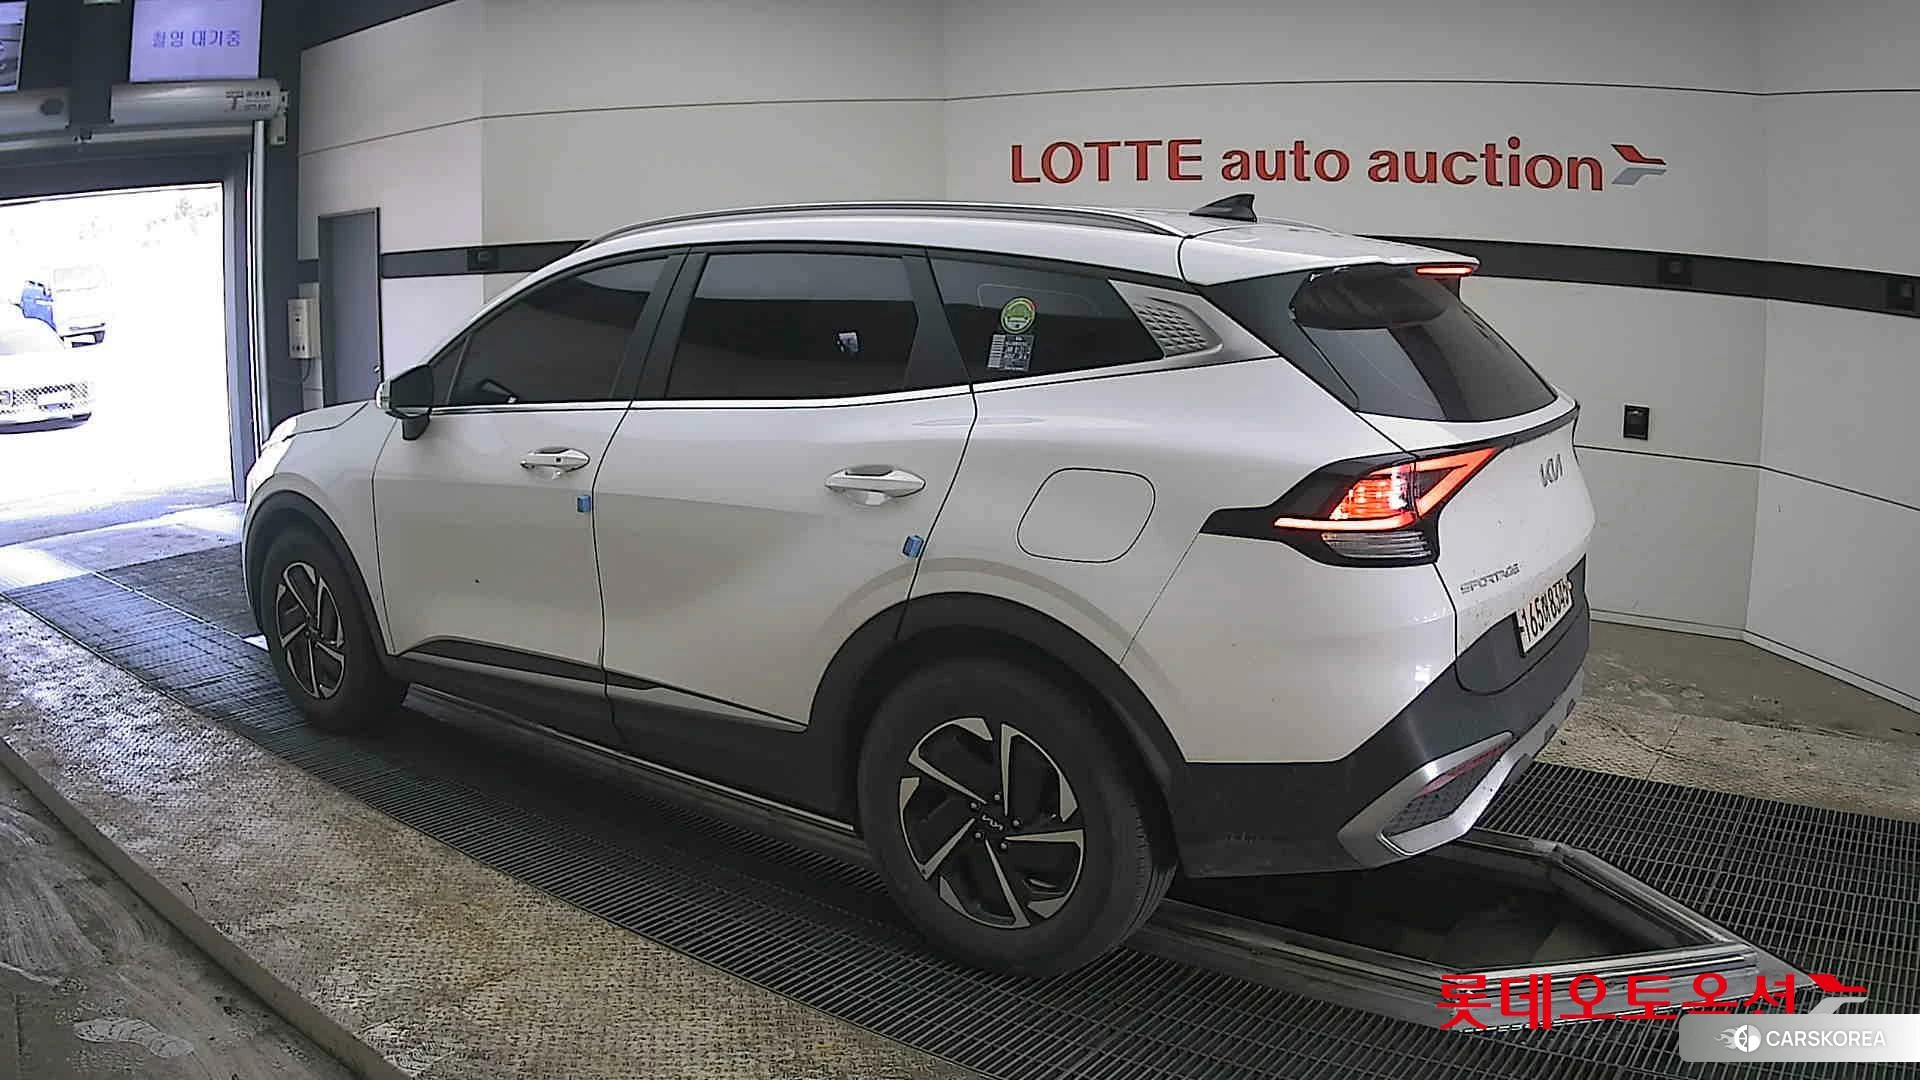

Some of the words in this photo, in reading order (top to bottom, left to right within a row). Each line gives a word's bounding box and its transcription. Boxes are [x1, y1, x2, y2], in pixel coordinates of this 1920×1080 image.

[191, 29, 241, 48] 대기중
[1010, 138, 1204, 184] LOTTE
[1220, 140, 1350, 183] auto
[1367, 136, 1604, 191] auction
